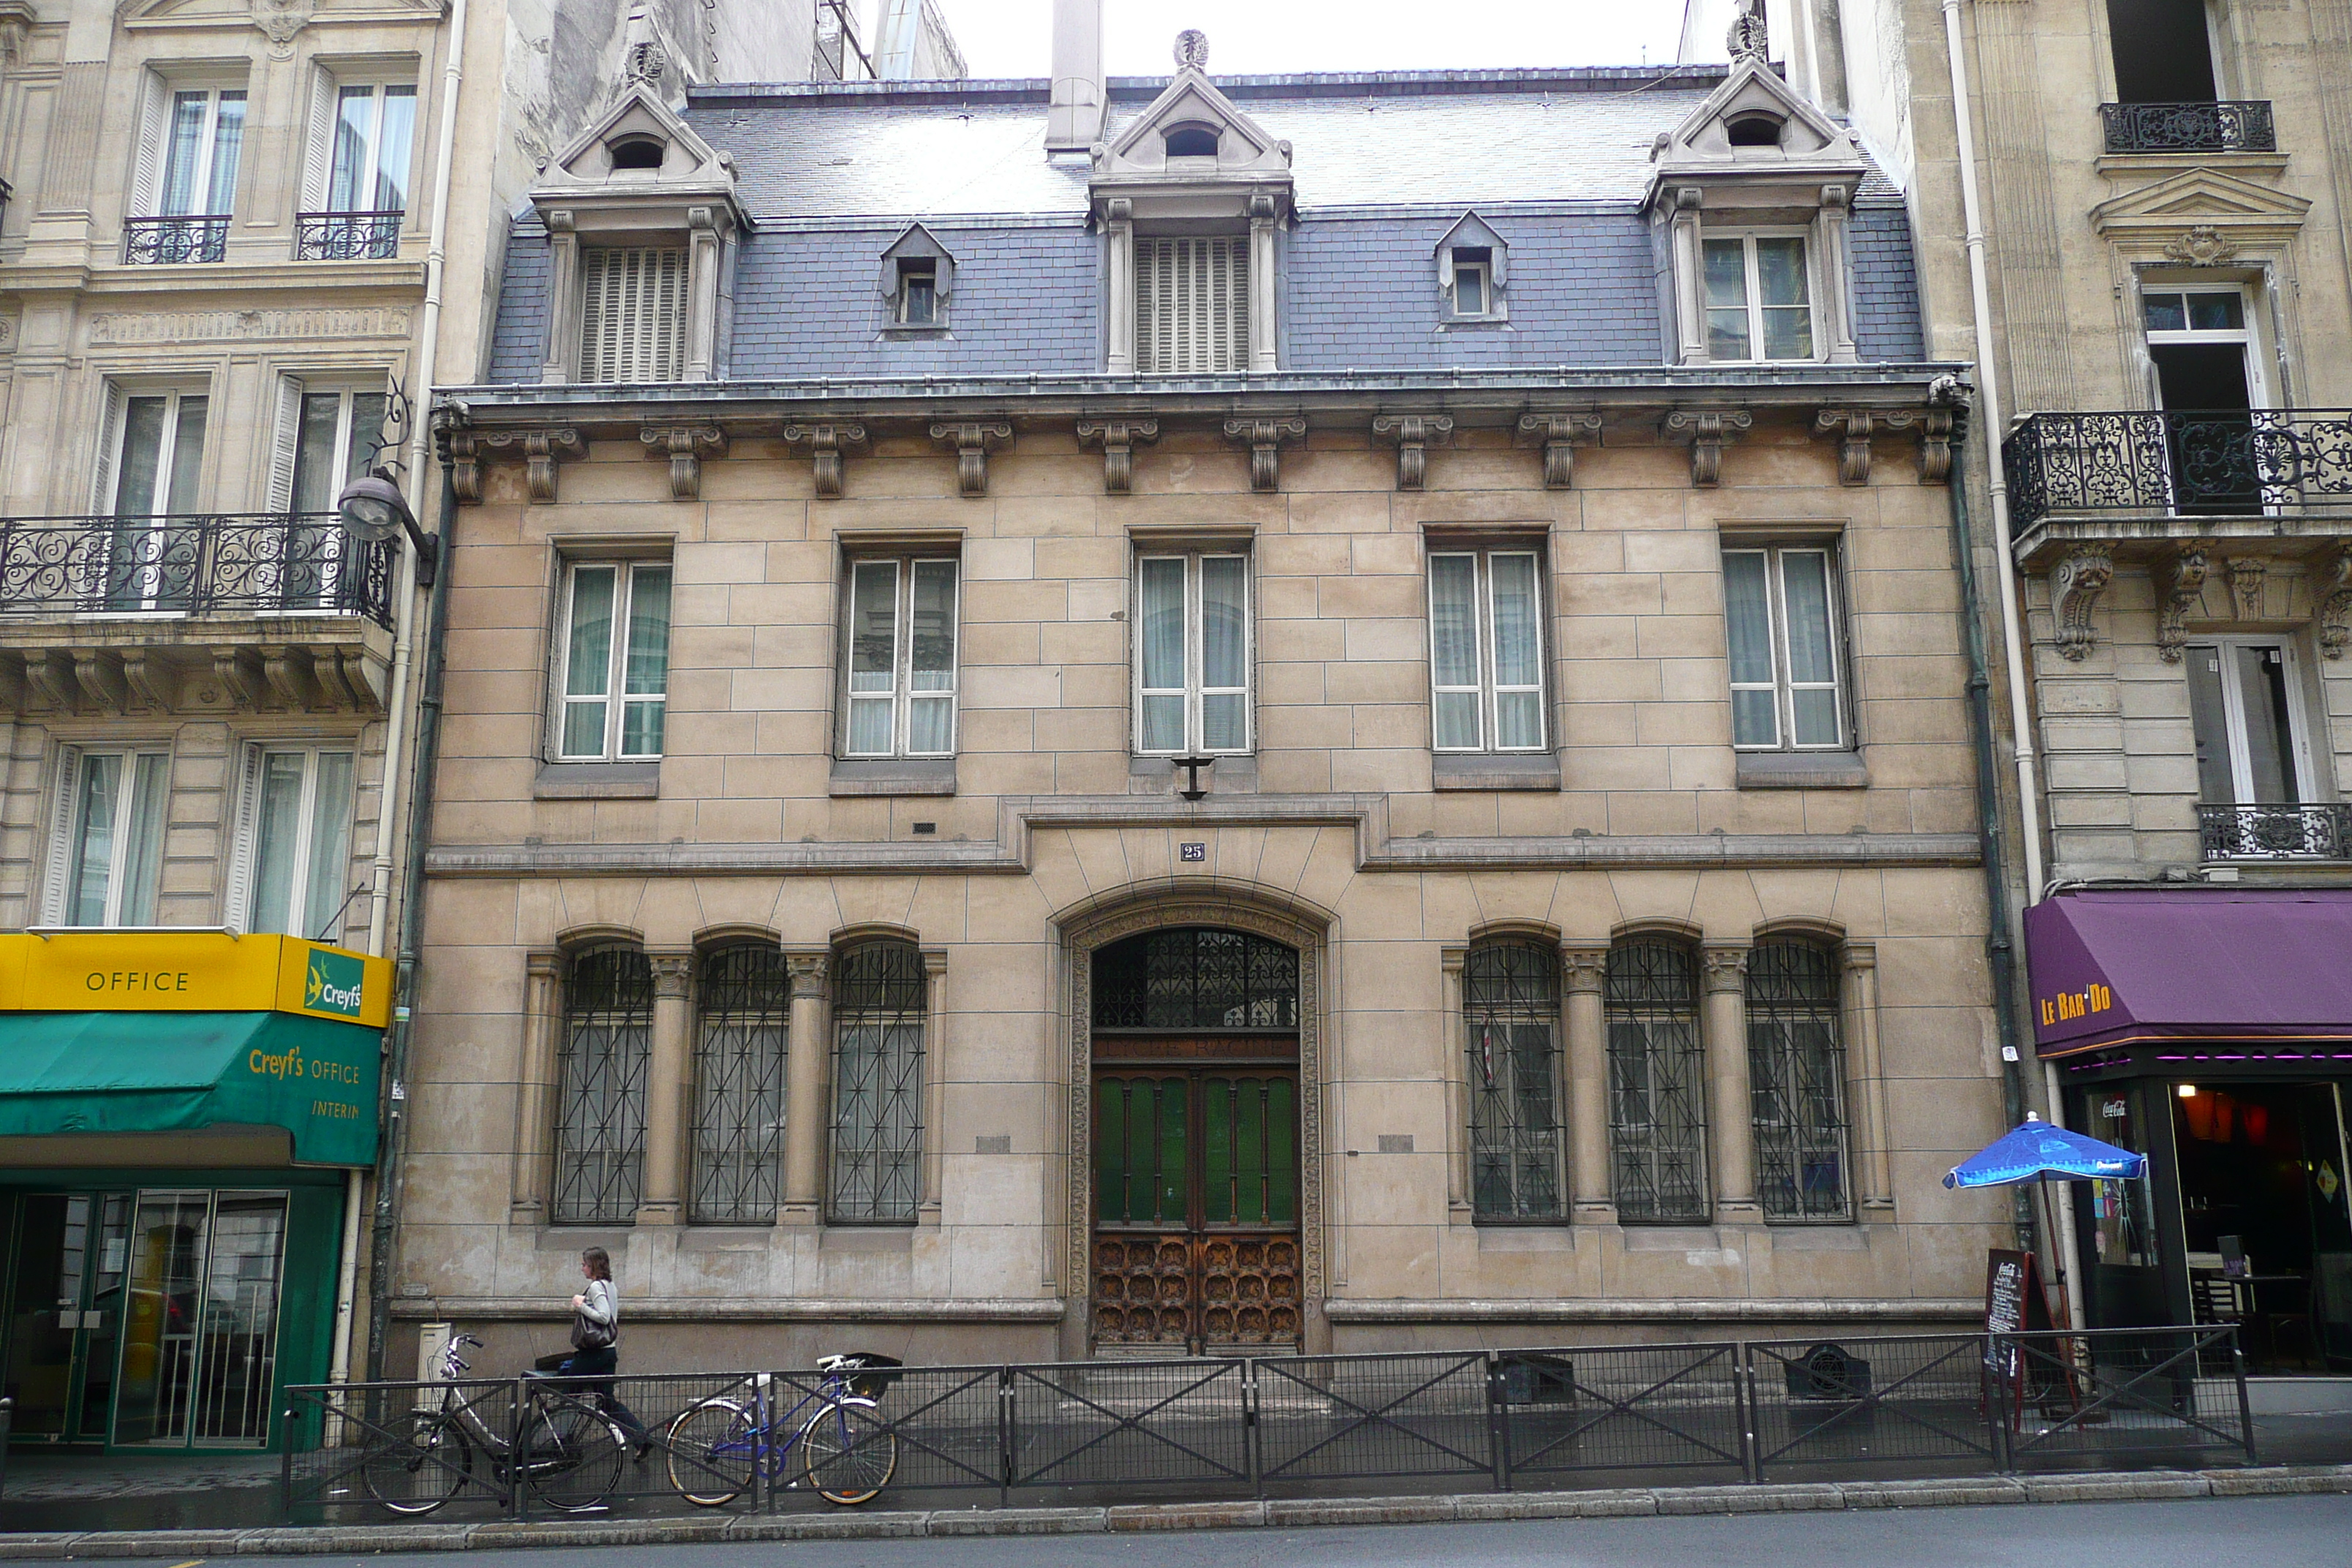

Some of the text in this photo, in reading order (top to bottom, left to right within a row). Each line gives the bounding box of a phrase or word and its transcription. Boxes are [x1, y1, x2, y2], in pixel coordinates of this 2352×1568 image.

[1185, 845, 1202, 859] 25
[86, 972, 189, 991] OFFICE
[323, 983, 361, 1011] Creyf's
[1194, 1039, 1289, 1057] RACINE
[249, 1046, 359, 1084] Creyf's OFFICE
[312, 1100, 359, 1120] INTERIM
